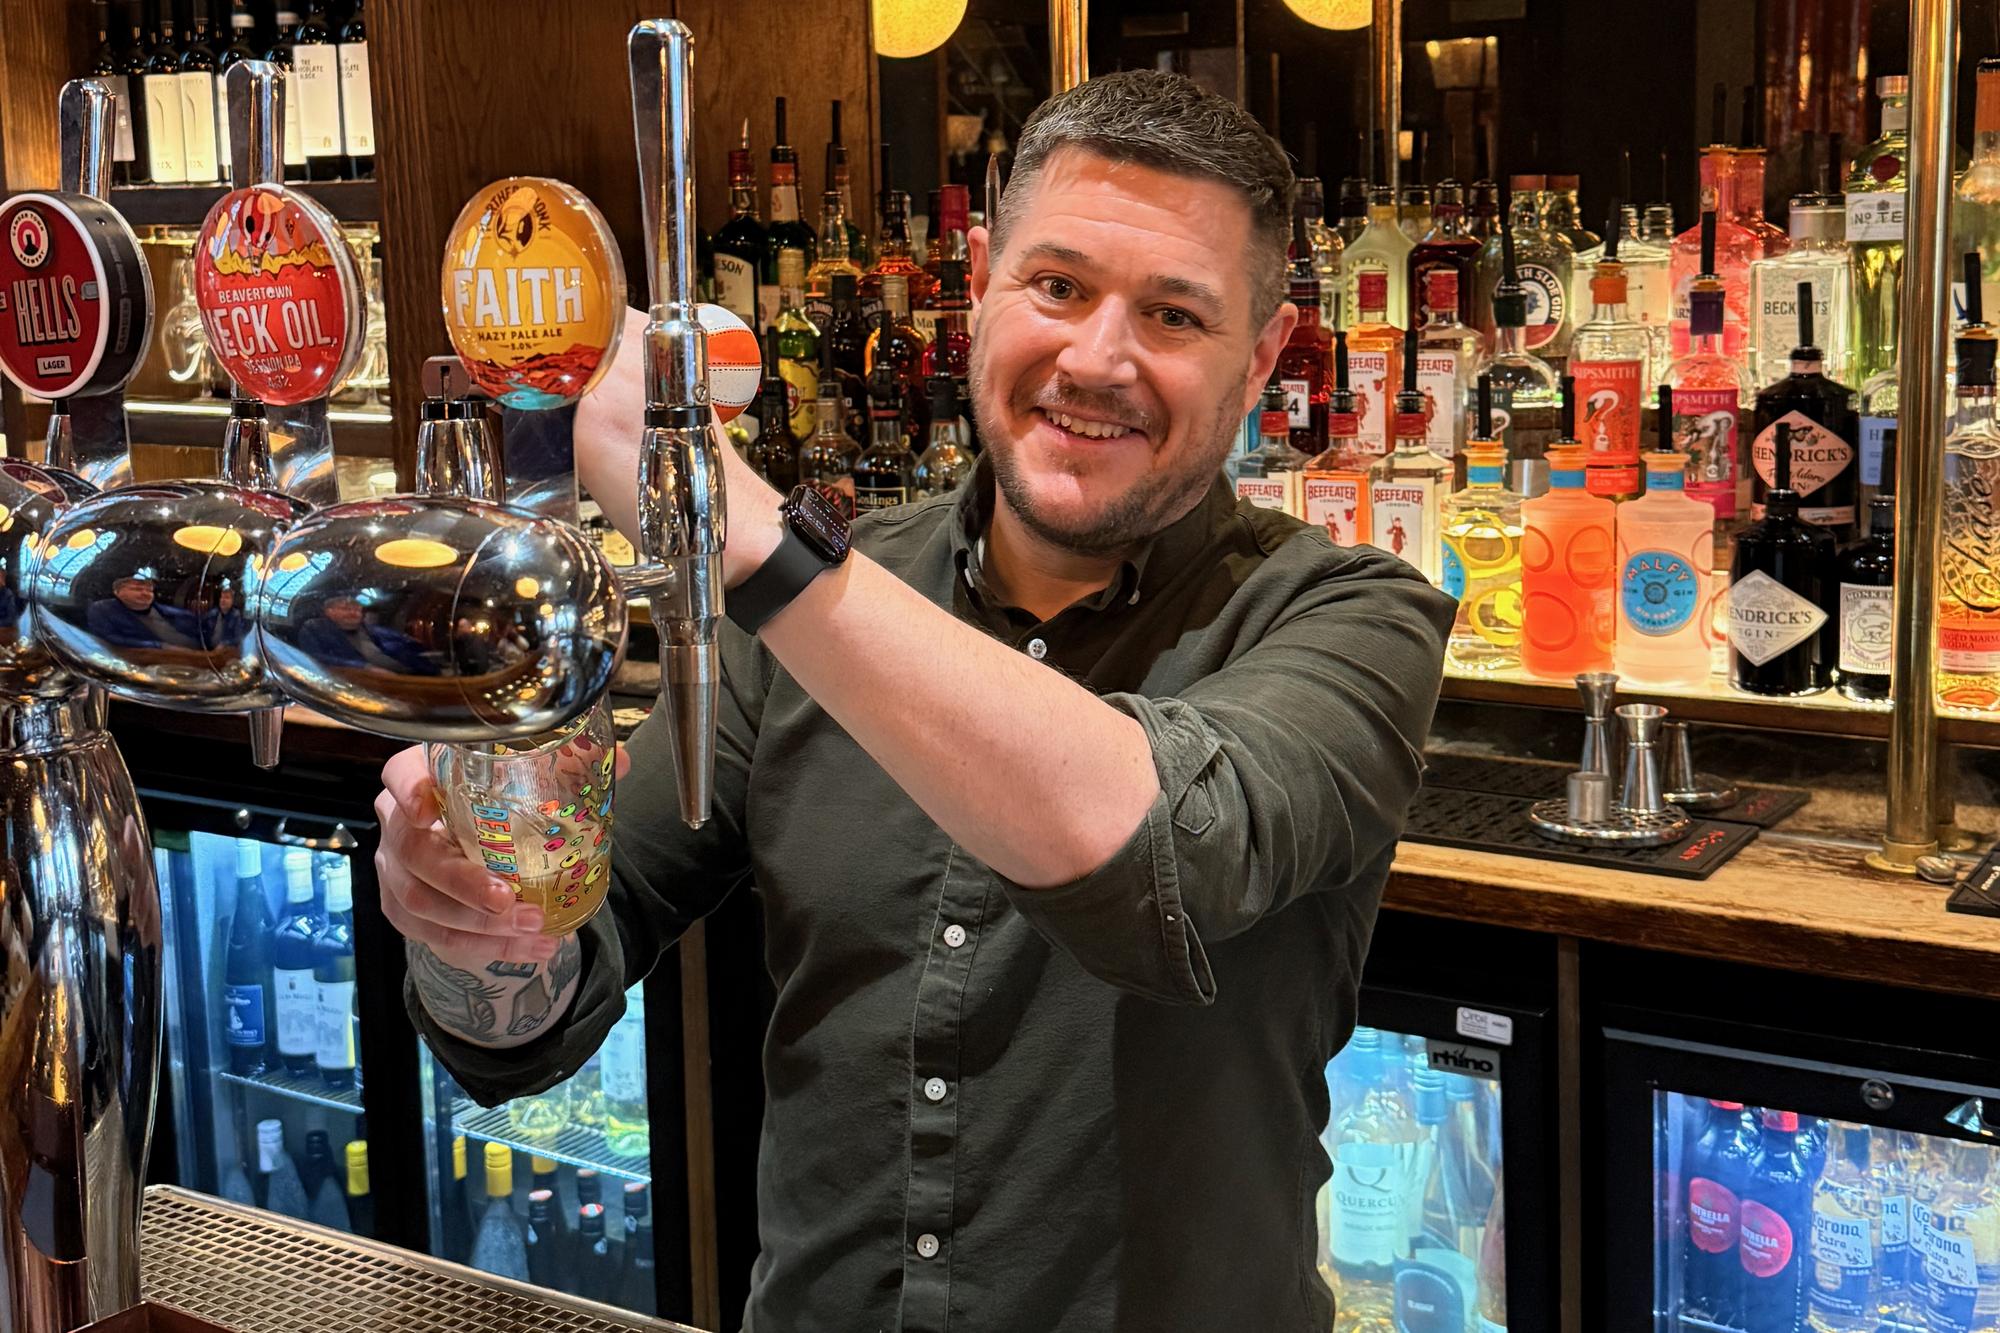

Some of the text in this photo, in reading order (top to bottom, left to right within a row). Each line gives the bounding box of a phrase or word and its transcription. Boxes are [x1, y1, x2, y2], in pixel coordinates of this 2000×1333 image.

[1877, 211, 1903, 223] TE
[219, 285, 293, 303] BEAVERTOWN
[454, 267, 585, 327] FAITH
[13, 275, 81, 343] HELLS
[1550, 297, 1562, 320] GIN
[1764, 301, 1828, 315] BECKTS
[478, 328, 562, 341] HAZY PALE ALE
[43, 360, 66, 370] LAGER
[1349, 357, 1385, 372] EFEATER
[1416, 359, 1453, 375] EFEATER
[1573, 366, 1637, 379] SIPSMITH
[1674, 392, 1730, 404] PSMITH
[1288, 398, 1299, 415] 4
[1754, 447, 1848, 462] HENRICK'S
[1238, 484, 1284, 499] BEEFEATER
[1308, 485, 1357, 500] BEEFEATER
[1374, 488, 1424, 506] BEEFEATER
[1627, 559, 1689, 580] MALFY
[1729, 607, 1812, 625] ENDRICK'S
[1744, 630, 1774, 639] GIN
[1433, 1047, 1493, 1072] rhino
[1336, 1190, 1402, 1208] QUERCU
